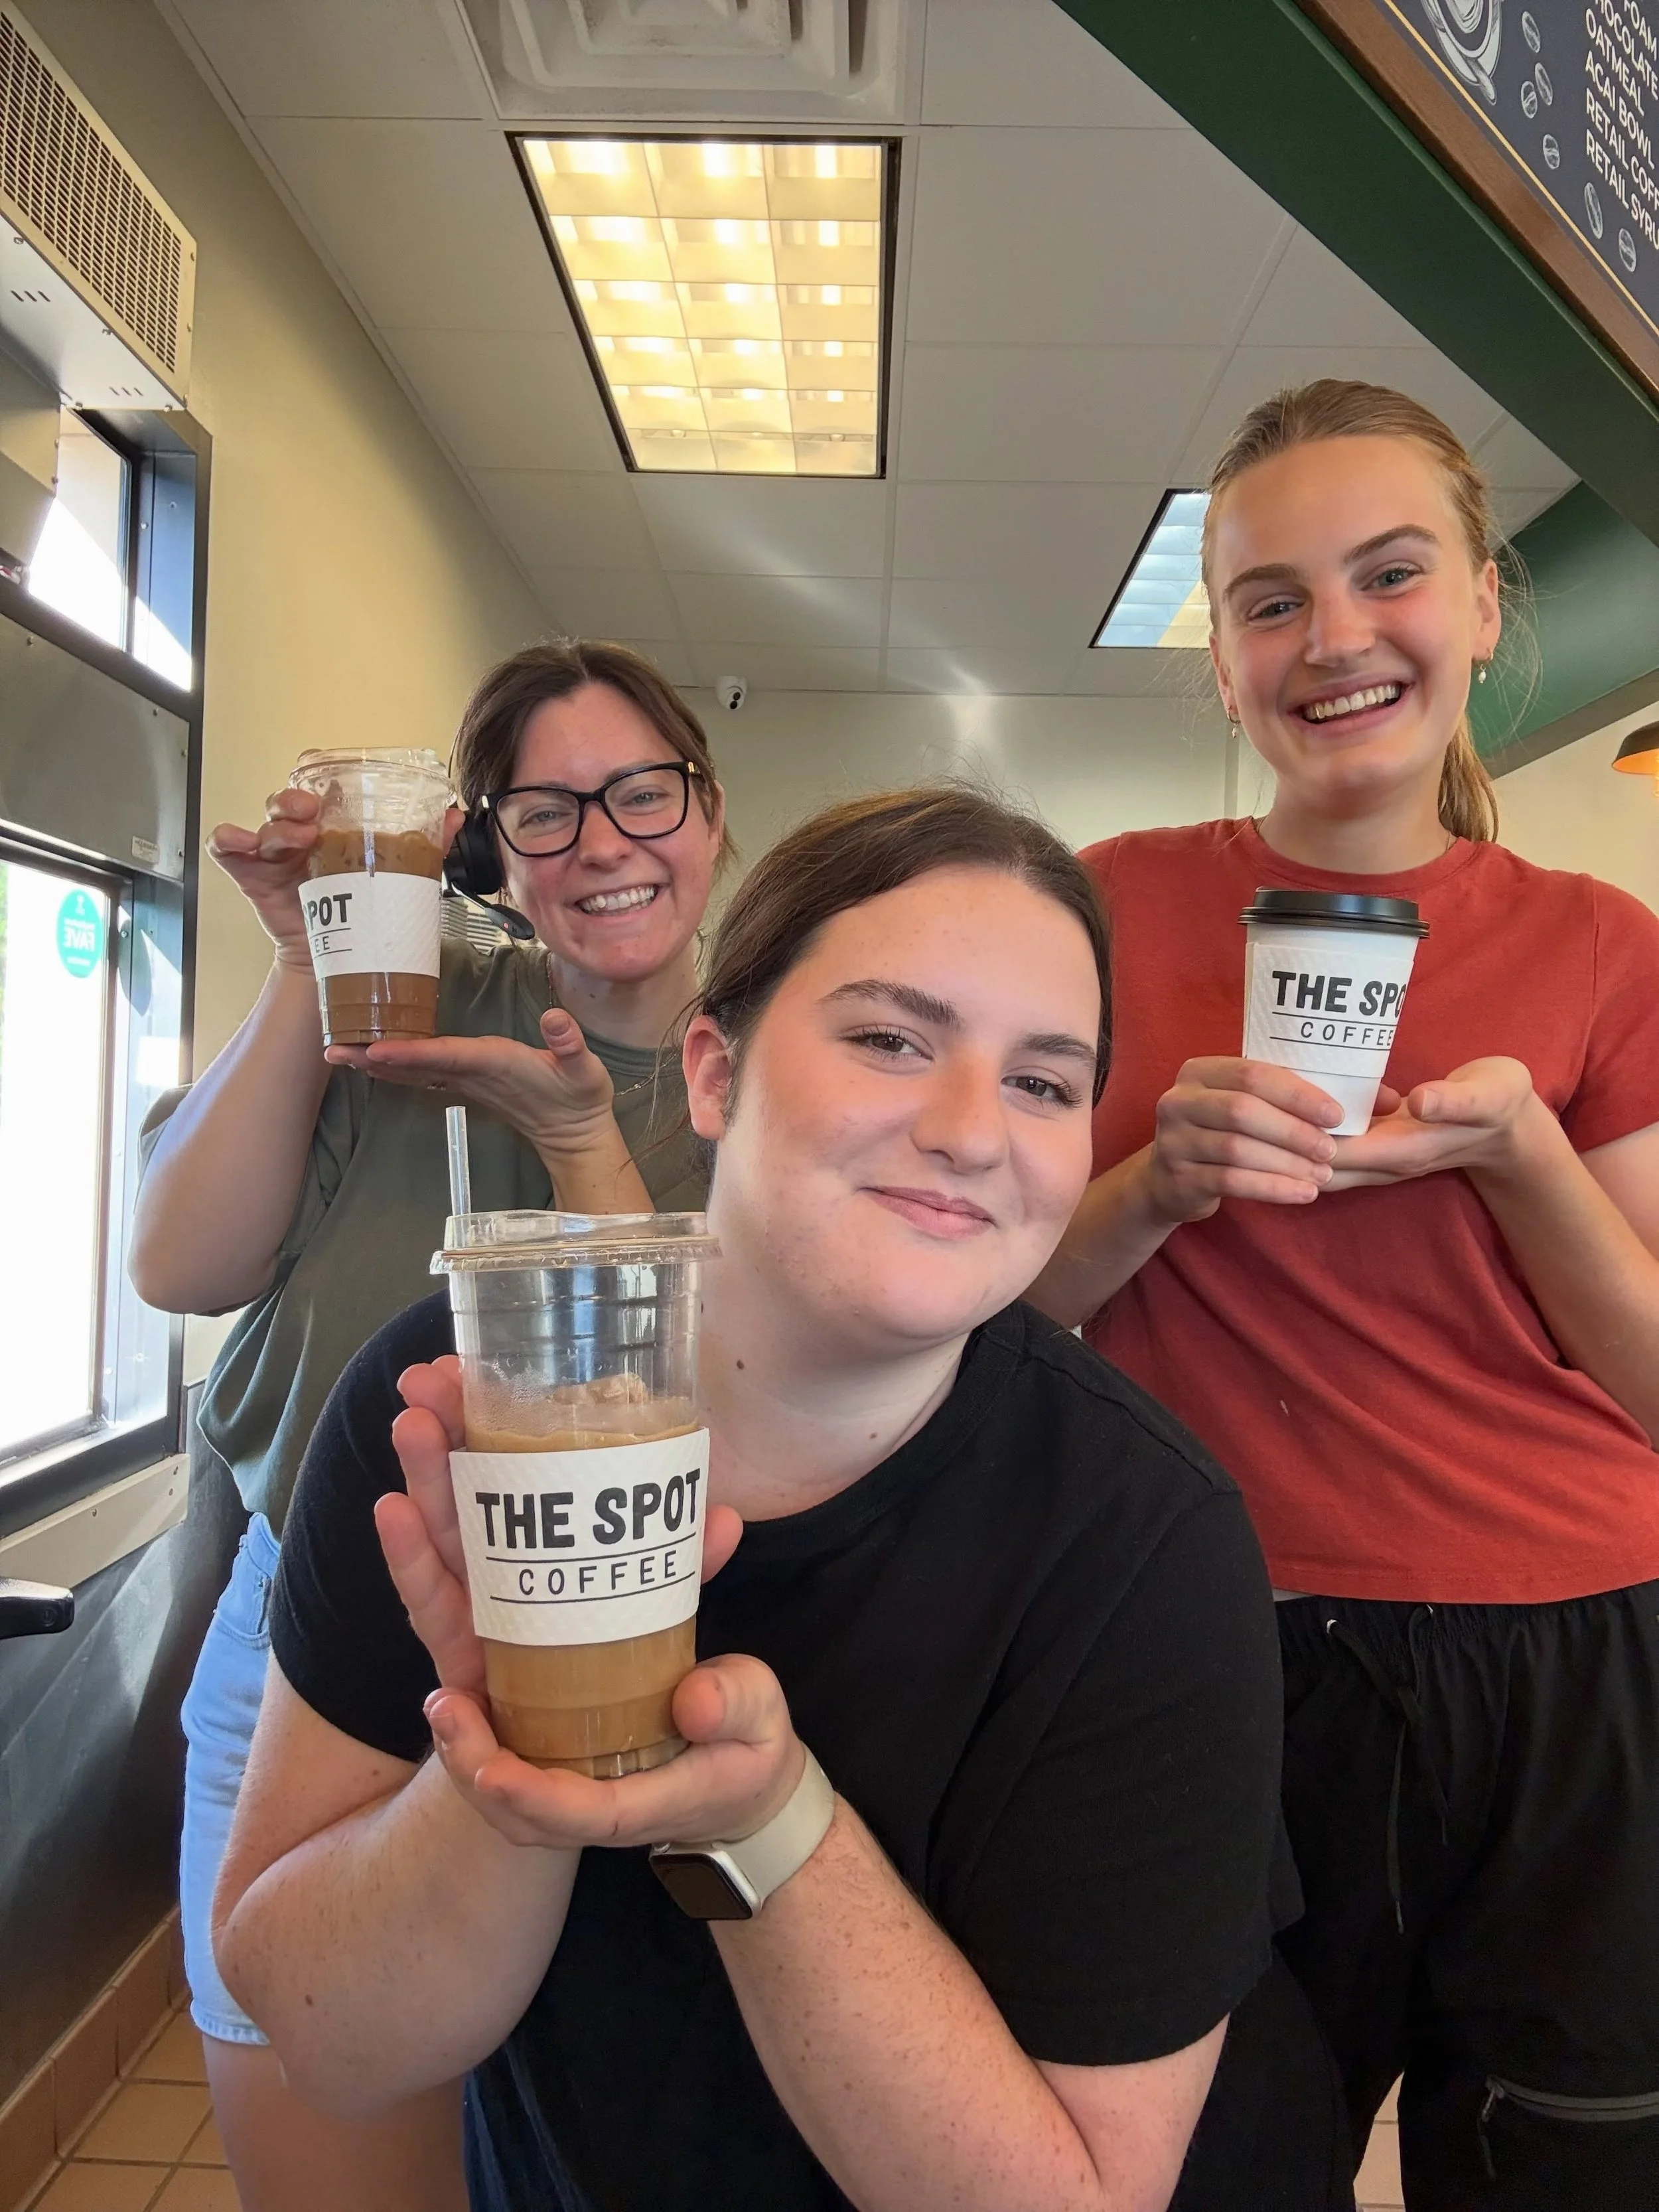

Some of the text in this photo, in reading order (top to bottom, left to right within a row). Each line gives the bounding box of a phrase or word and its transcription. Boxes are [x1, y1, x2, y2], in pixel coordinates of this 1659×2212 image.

[1586, 8, 1644, 117] OATMEAL
[1585, 50, 1655, 170] ACAI BOWL
[1586, 88, 1629, 171] RETAIL
[1586, 129, 1630, 210] RETAIL
[303, 893, 352, 930] POT
[1272, 970, 1352, 1013] THE
[1300, 1021, 1394, 1046] COFFEE
[475, 1468, 700, 1549] THE SPOT
[518, 1550, 677, 1595] COFFEE
